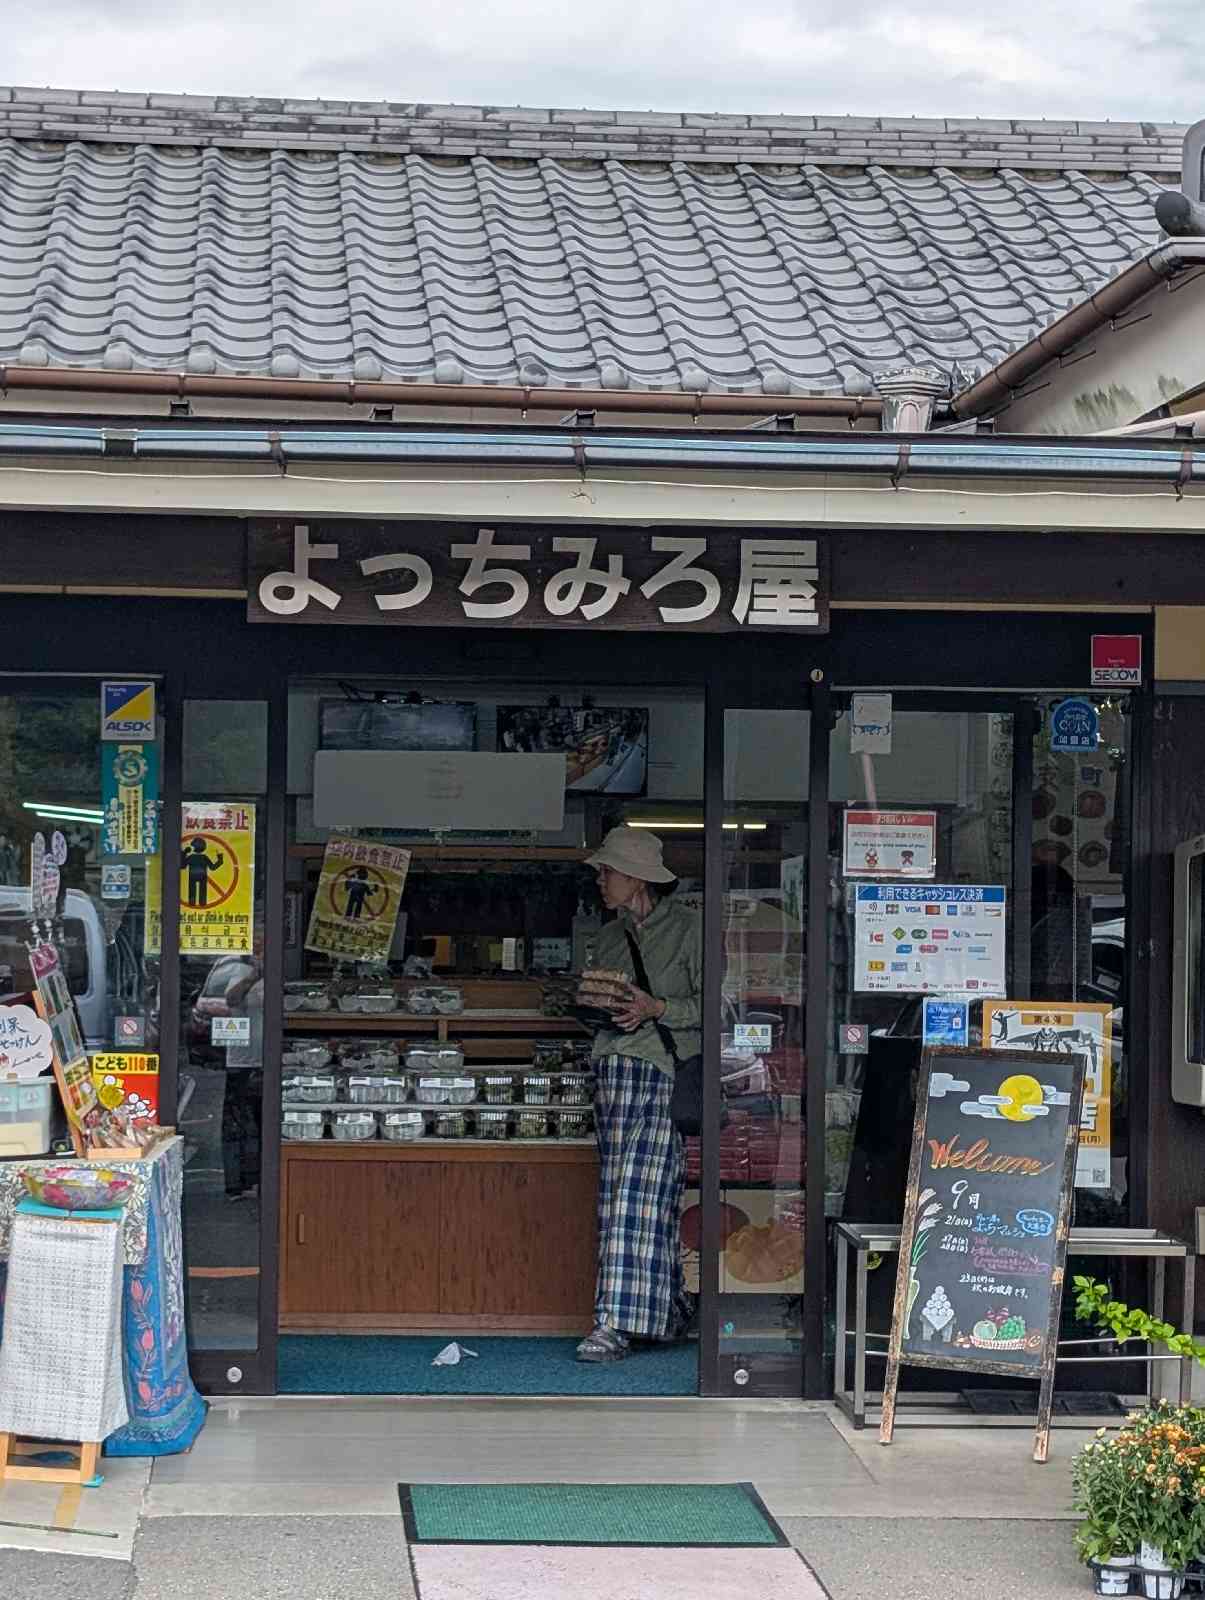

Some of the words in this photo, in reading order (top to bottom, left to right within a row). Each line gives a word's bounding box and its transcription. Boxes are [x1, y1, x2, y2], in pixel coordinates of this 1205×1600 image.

[258, 525, 819, 625] よっちみろ屋
[1094, 670, 1138, 681] SECOM
[105, 721, 152, 731] ALSOK
[878, 887, 984, 901] 利用できるキャッシュレス決済
[96, 1056, 157, 1071] こども110番
[928, 1134, 1055, 1176] Welcome
[951, 1180, 980, 1210] 9月
